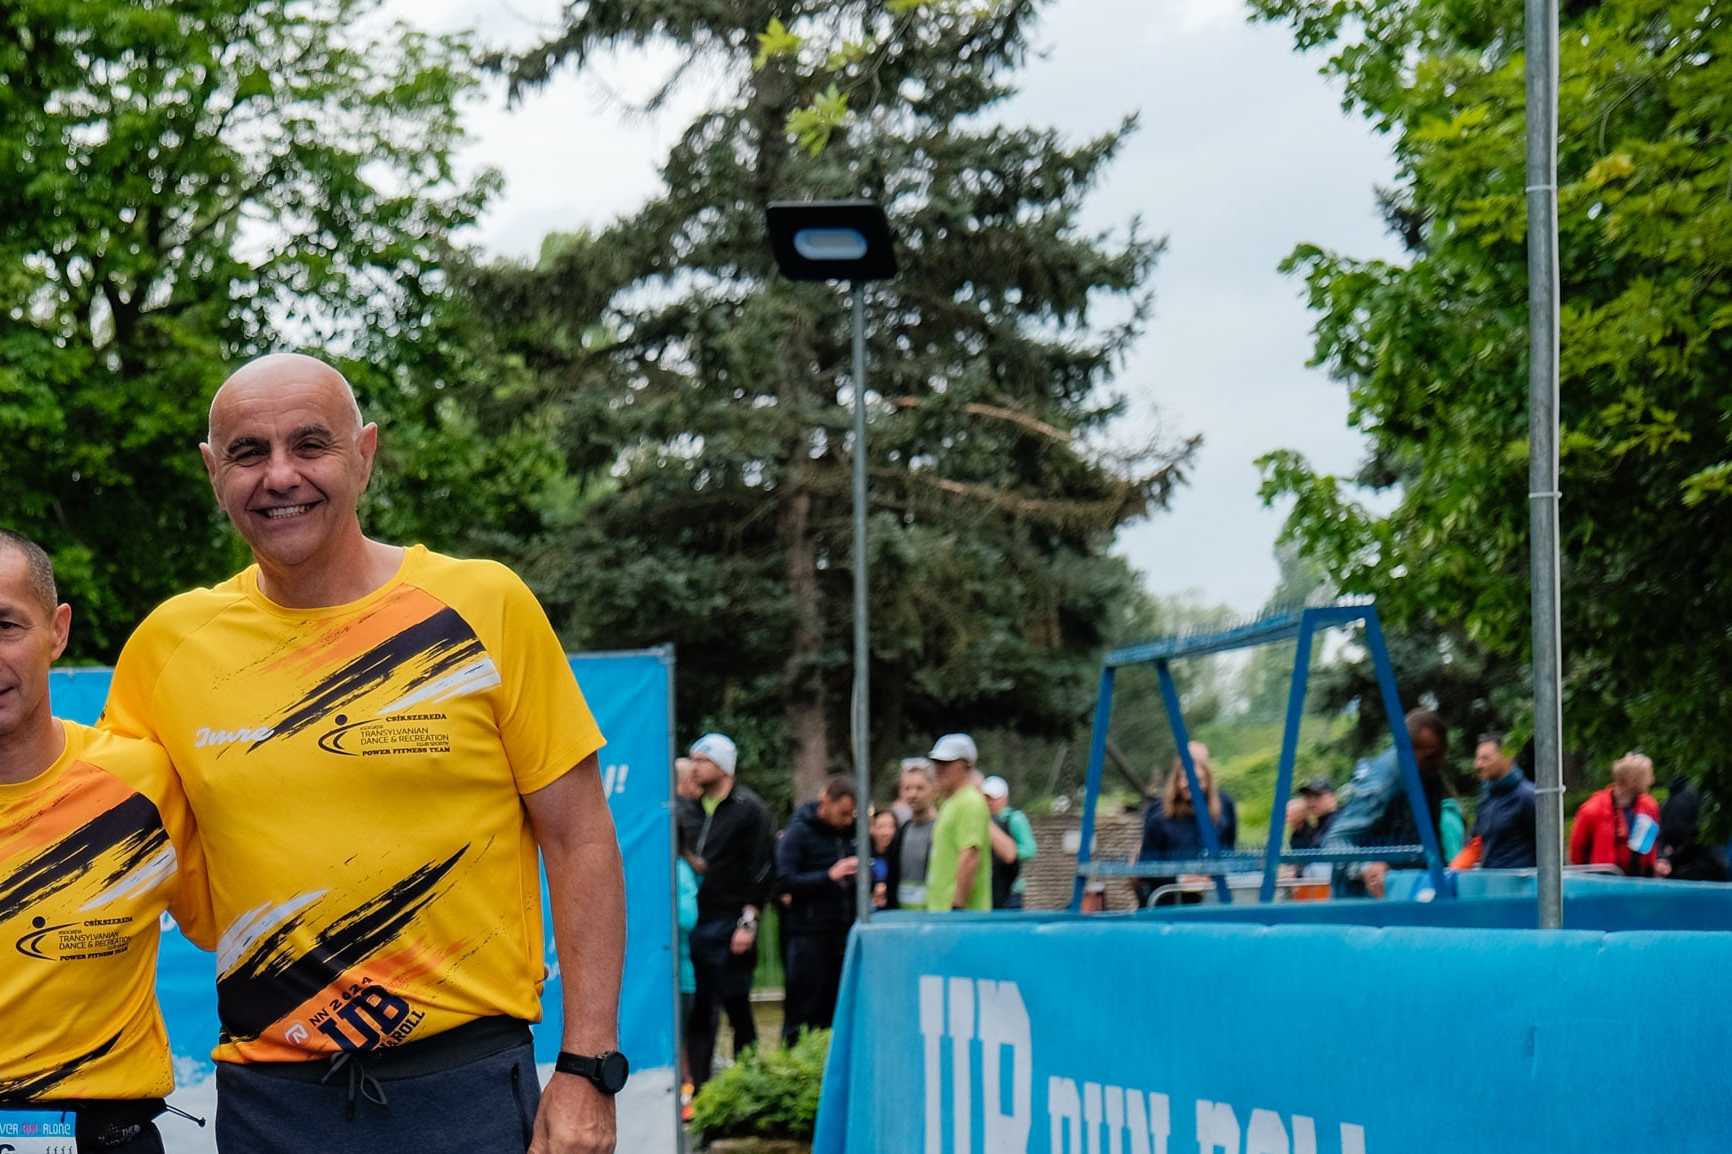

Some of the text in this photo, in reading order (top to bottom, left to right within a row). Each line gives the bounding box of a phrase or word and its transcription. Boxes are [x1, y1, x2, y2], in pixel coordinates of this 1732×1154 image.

[195, 726, 275, 748] Imre
[360, 733, 449, 745] DANCE & RECREATION
[361, 727, 428, 738] TRANSYLVANIAN
[362, 749, 391, 757] POWER
[393, 747, 428, 755] FITNESS
[59, 931, 119, 942] TRANSYLVANIAN
[59, 941, 86, 950] DANCE
[87, 941, 94, 949] &
[94, 936, 132, 948] RECREATION
[309, 976, 373, 1027] NN 2024
[318, 985, 409, 1051] UB
